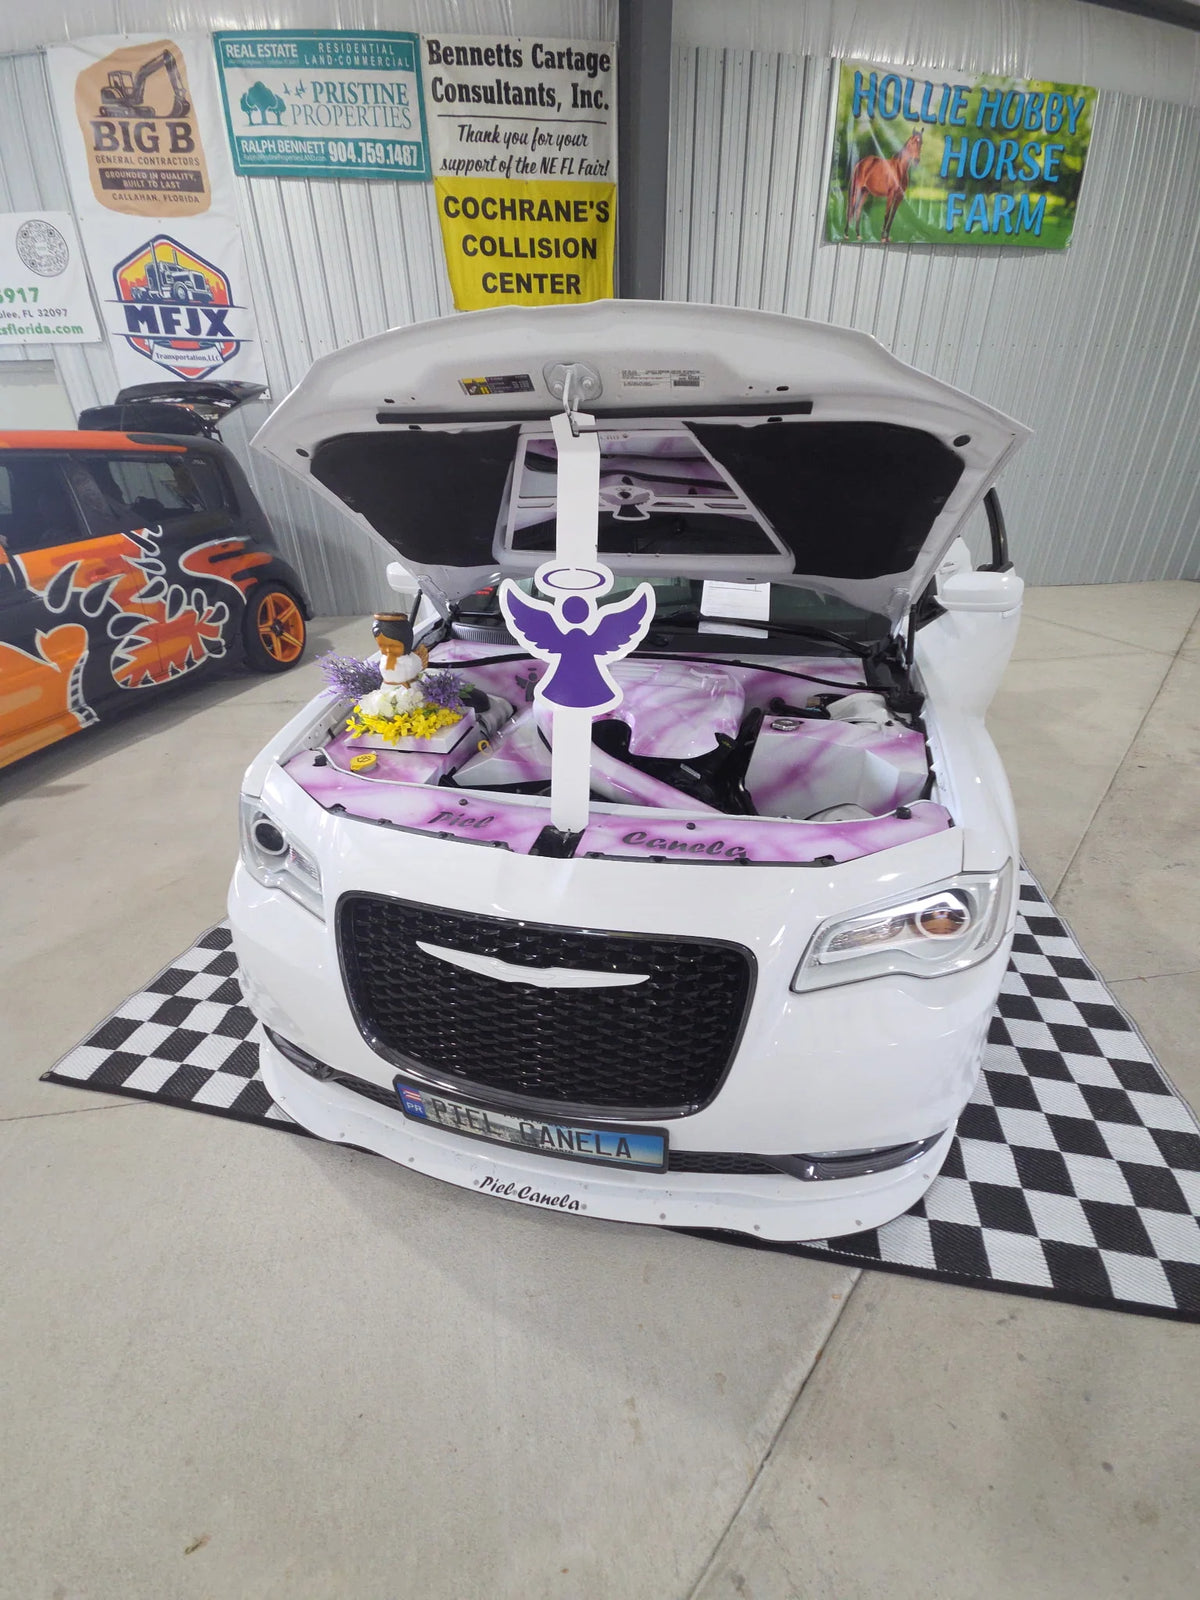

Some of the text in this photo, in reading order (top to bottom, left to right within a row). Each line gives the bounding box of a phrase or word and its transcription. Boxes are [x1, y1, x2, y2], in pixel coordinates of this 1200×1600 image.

[225, 43, 299, 58] REAL ESTATE
[318, 42, 395, 54] RESIDENTIAL
[427, 39, 611, 78] Bennetts Cartage
[311, 80, 410, 107] PRISTINE
[431, 76, 610, 113] Consultants, Inc.
[852, 70, 1085, 135] HOLLIE HOBBY
[290, 103, 412, 130] PROPERTIES
[89, 120, 196, 154] BIG B
[457, 124, 589, 151] Thank you for your
[95, 154, 201, 167] GENERAL CONTRACTORS
[241, 139, 418, 167] RALPH BENNETT 904.759.1487
[440, 154, 610, 179] support of the NE FL Fair!
[940, 135, 1065, 183] HORSE
[104, 170, 198, 182] GROUNDED IN QUALITY,
[122, 179, 145, 188] BUILT
[160, 181, 182, 190] LAST
[163, 193, 200, 204] FLORIDA
[443, 195, 610, 224] COCHRANE'S
[944, 193, 1047, 237] FARM
[462, 234, 598, 260] COLLISION
[481, 271, 582, 295] CENTER
[22, 309, 34, 319] FL
[37, 308, 68, 318] 32097
[123, 304, 236, 338] MFJX
[427, 811, 747, 858] Piel Canela
[405, 1101, 424, 1114] PR
[430, 1097, 502, 1136] PIEL
[518, 1121, 632, 1159] CANELA
[478, 1175, 580, 1211] Piel Canela
